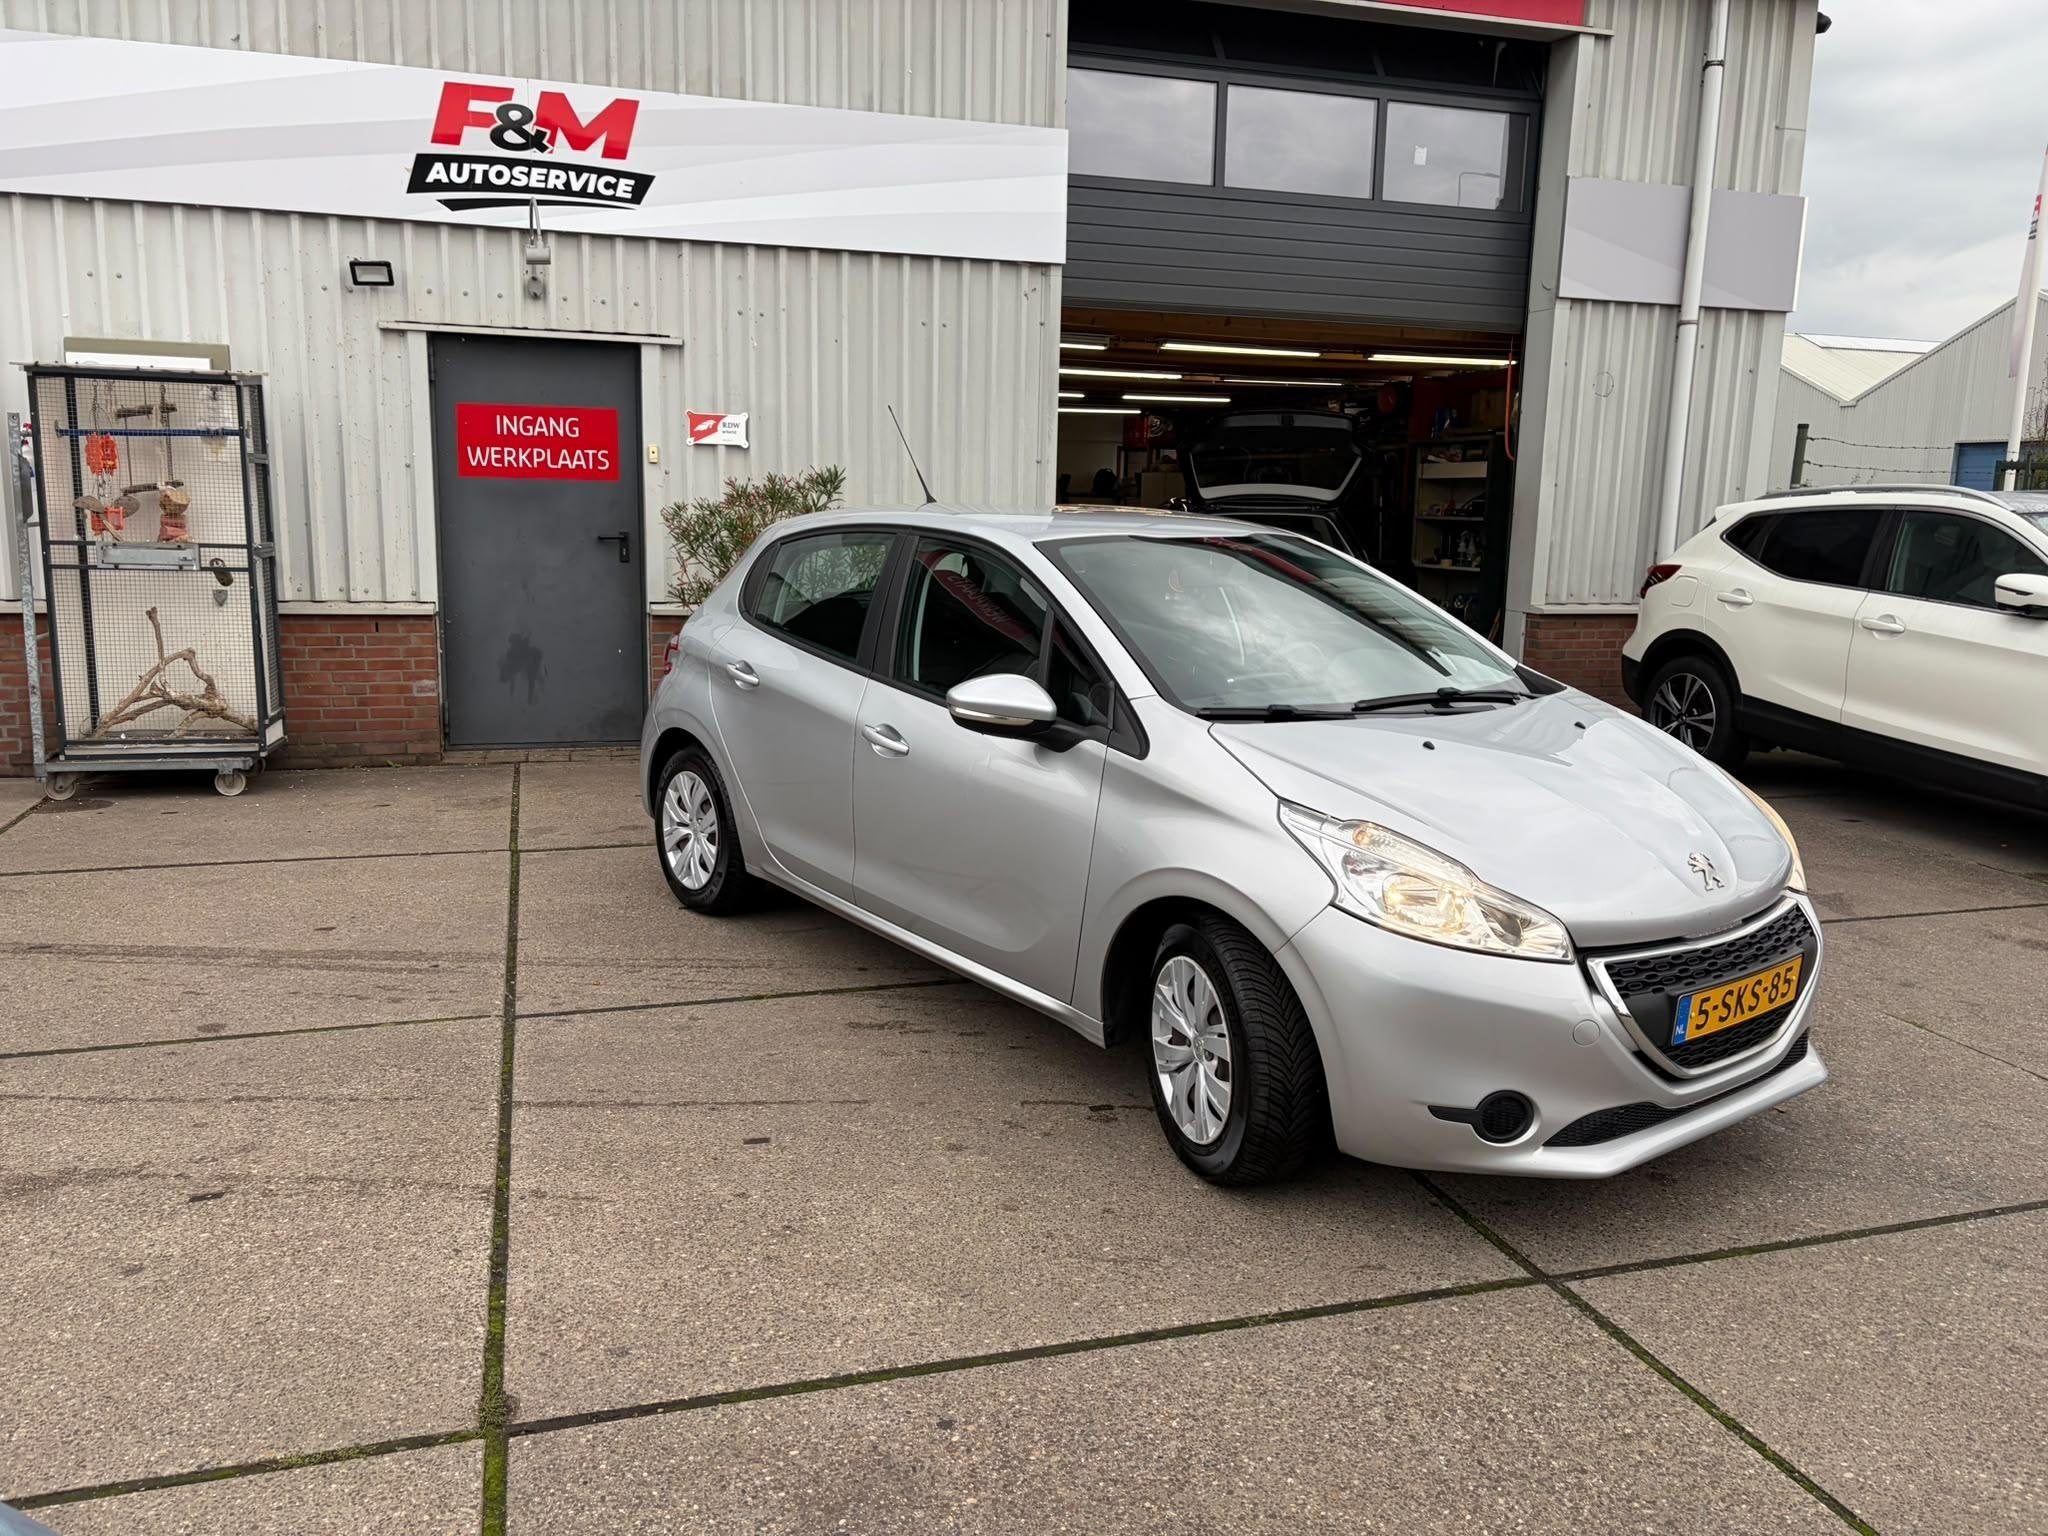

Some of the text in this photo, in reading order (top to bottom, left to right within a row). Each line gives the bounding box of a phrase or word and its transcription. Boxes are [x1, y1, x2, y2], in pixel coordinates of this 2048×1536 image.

[431, 81, 640, 160] F&M
[425, 161, 636, 199] AUTOSERVICE
[495, 414, 580, 438] INGANG
[466, 445, 610, 470] WERKPLAATS
[1695, 965, 1795, 1030] 5-SKS-85
